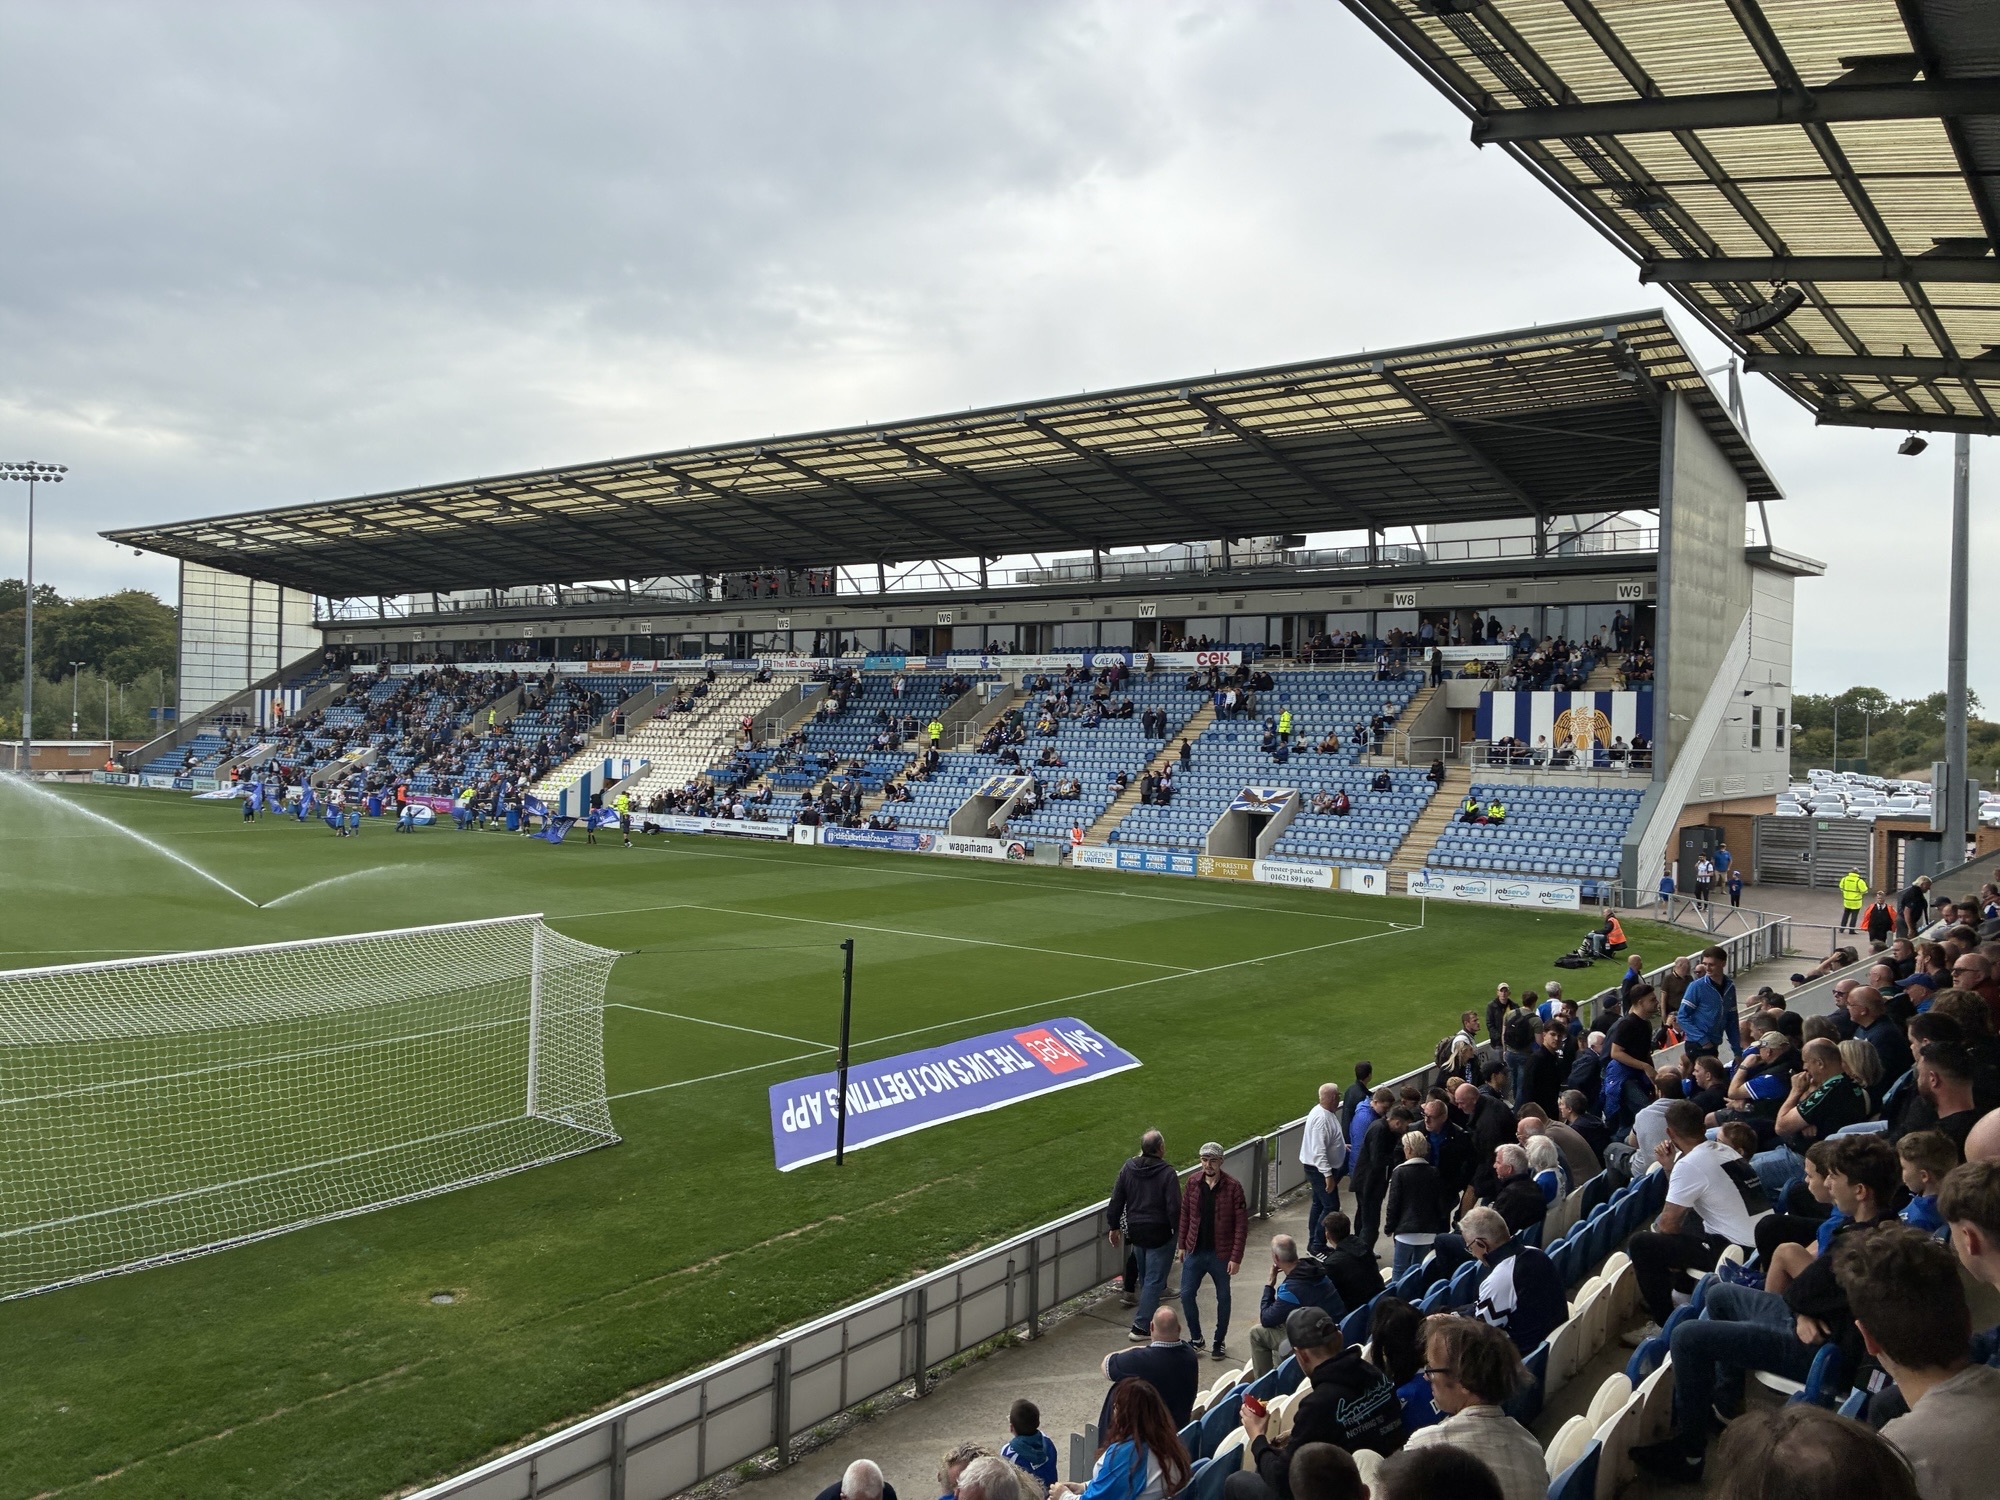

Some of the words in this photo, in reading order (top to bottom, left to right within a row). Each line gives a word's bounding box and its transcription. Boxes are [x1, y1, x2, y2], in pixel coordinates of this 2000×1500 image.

[1619, 584, 1641, 597] W9
[1396, 594, 1415, 606] W8
[1140, 605, 1156, 616] W7
[778, 619, 790, 628] W5
[938, 613, 952, 623] W6
[773, 660, 784, 668] The
[800, 660, 818, 669] Group
[950, 842, 993, 854] wagamama
[1214, 861, 1249, 871] FORRESTER
[1261, 863, 1324, 876] forrester-park.co.uk
[1222, 868, 1239, 876] PARK
[1270, 873, 1290, 881] 01621
[1452, 884, 1488, 894] jobserve
[1494, 887, 1530, 897] jobserve
[1538, 890, 1576, 900] jobserve
[1026, 1037, 1079, 1065] bet
[984, 1044, 1035, 1074] THE
[947, 1053, 1001, 1085] UK'S
[907, 1062, 960, 1097] NO.1
[825, 1071, 917, 1119] BETTING
[782, 1091, 822, 1133] APP
